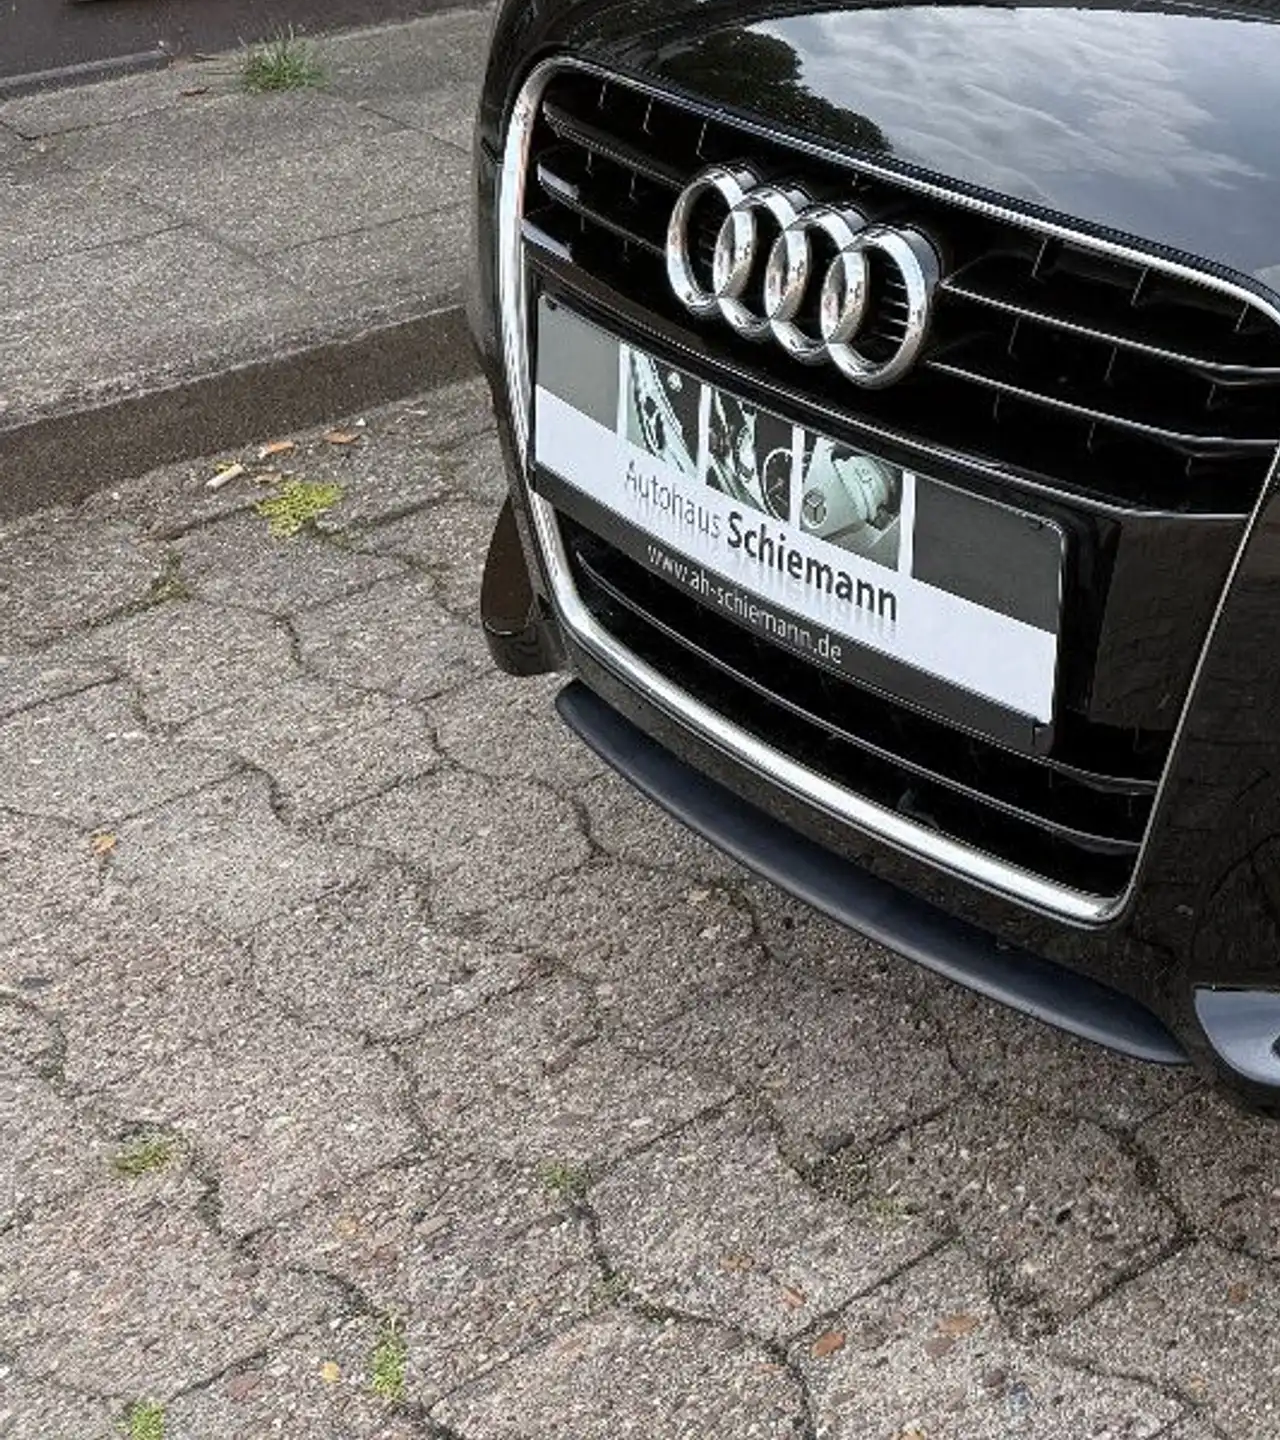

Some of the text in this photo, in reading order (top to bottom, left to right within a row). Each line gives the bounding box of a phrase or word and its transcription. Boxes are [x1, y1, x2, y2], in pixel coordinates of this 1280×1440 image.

[625, 460, 898, 622] Autohaus Schiemann
[648, 544, 843, 665] www.ah-schiemann.de
